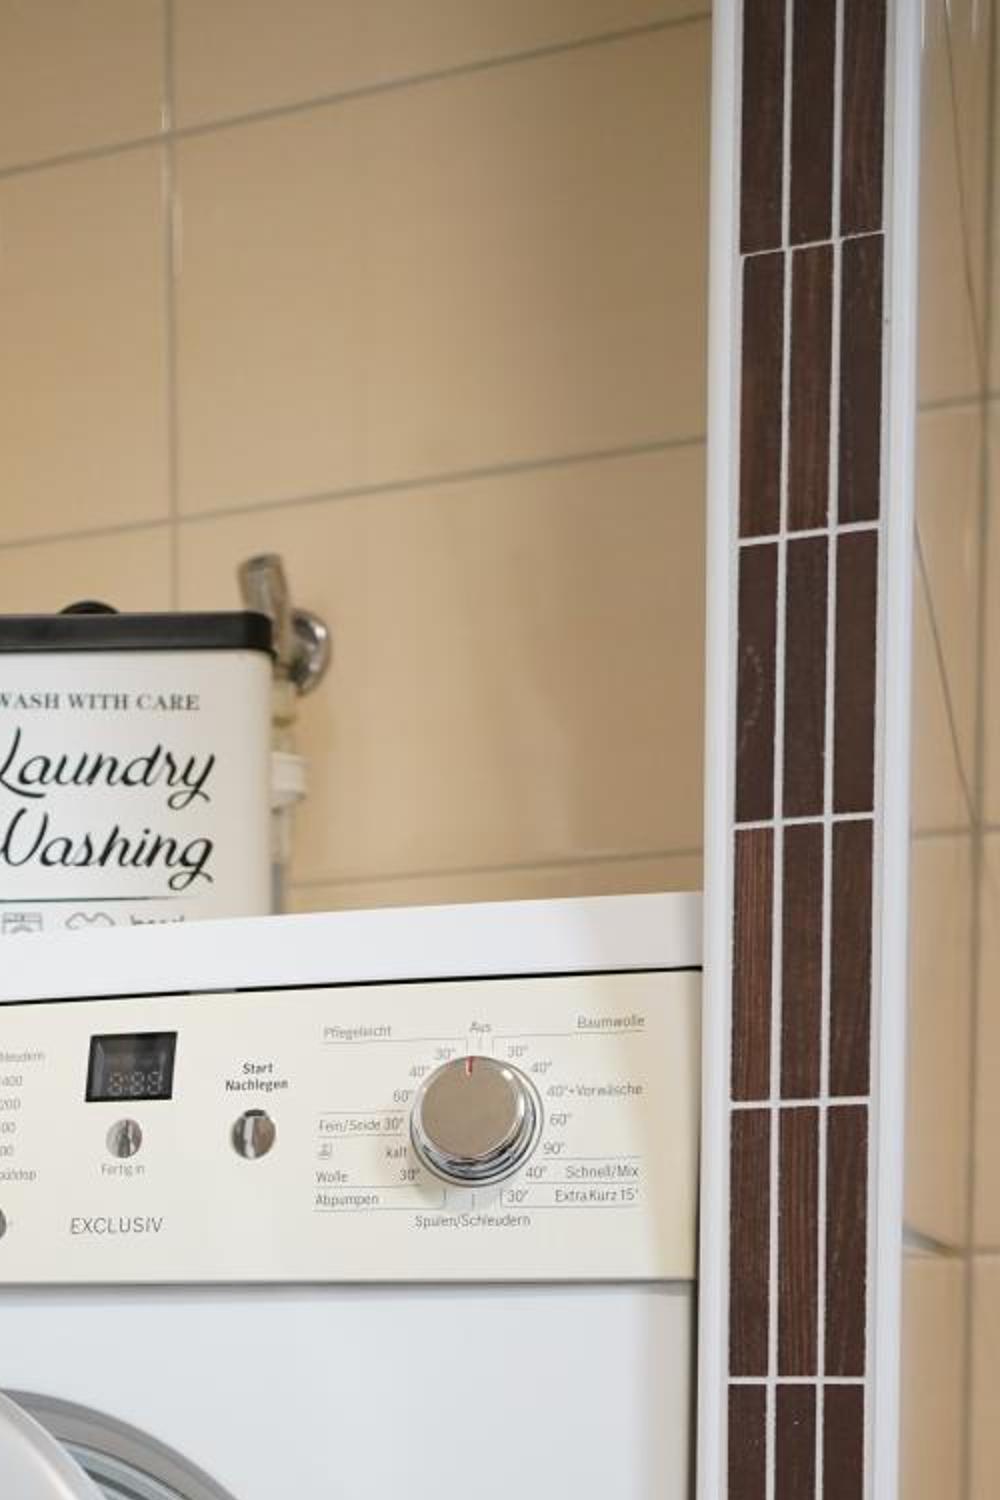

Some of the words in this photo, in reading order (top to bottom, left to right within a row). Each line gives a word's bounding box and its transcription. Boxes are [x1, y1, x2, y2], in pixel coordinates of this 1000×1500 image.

[68, 693, 128, 712] WITH
[136, 693, 201, 712] CARE
[469, 1021, 492, 1033] Aus
[242, 1062, 274, 1075] Start
[225, 1078, 289, 1092] Nachlegen
[70, 1217, 164, 1235] EXCLUSIV
